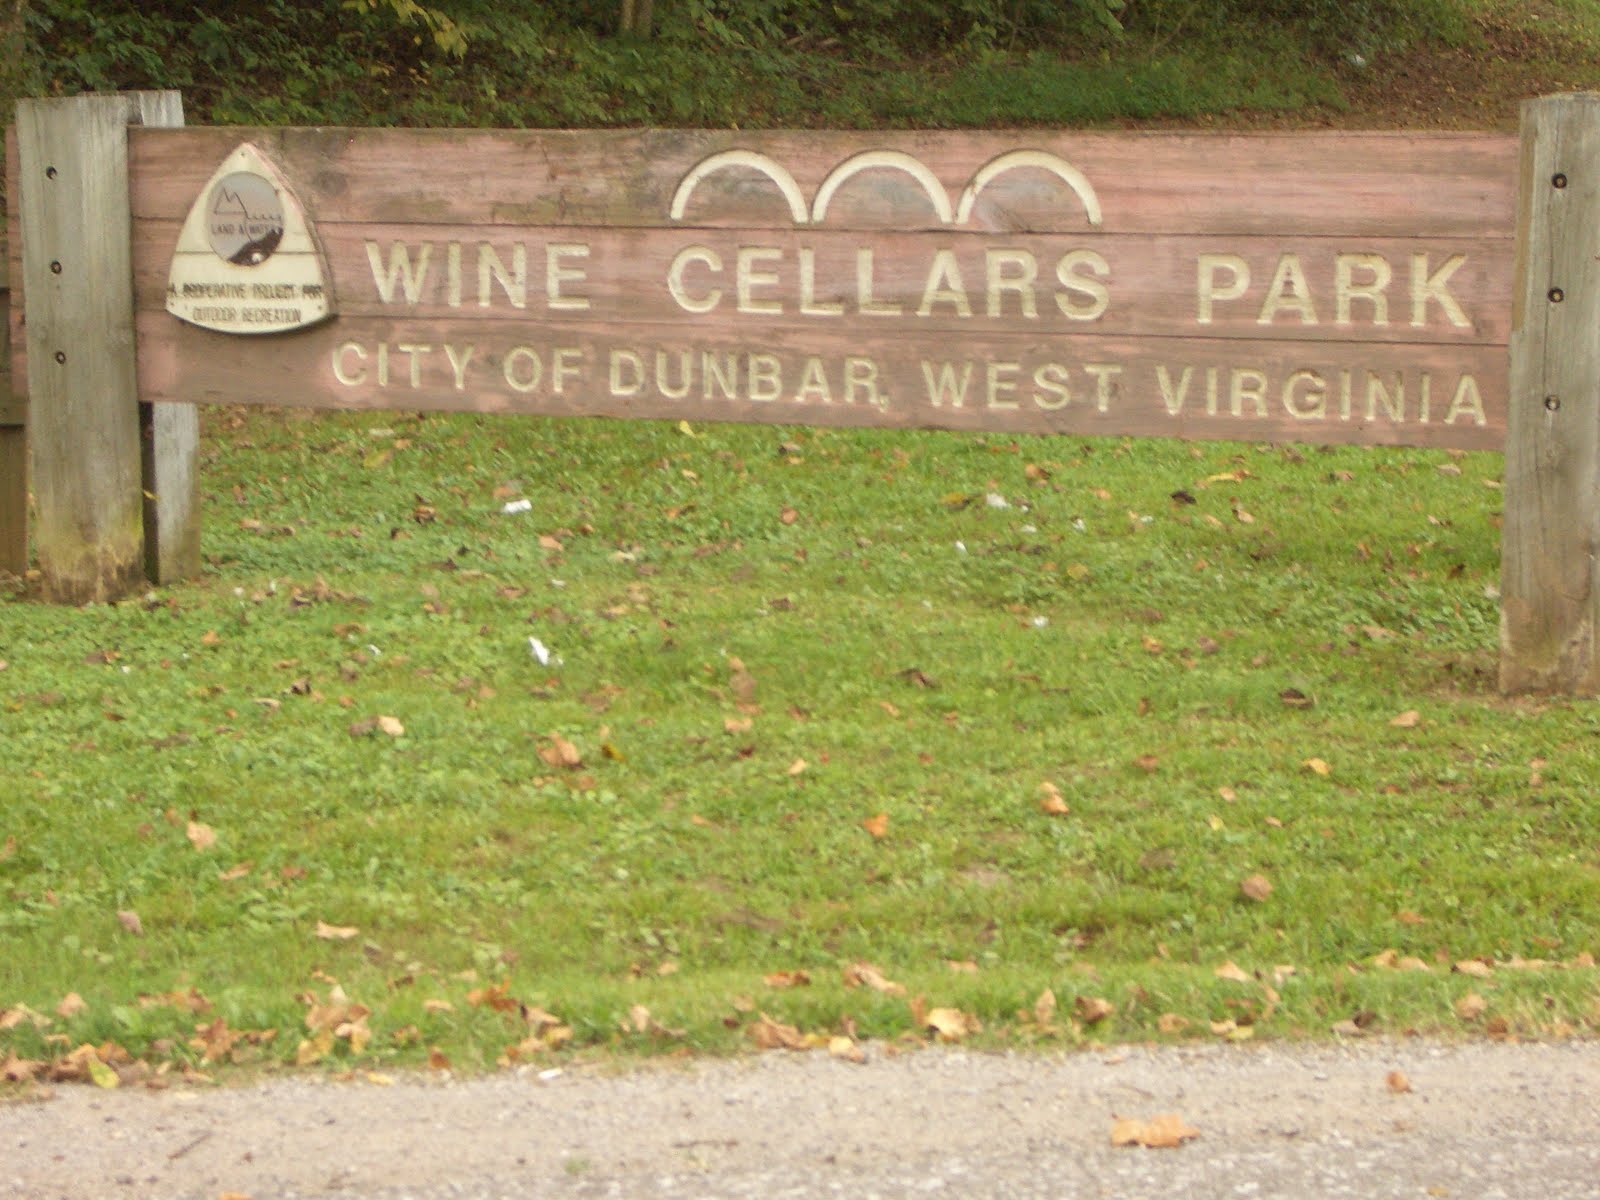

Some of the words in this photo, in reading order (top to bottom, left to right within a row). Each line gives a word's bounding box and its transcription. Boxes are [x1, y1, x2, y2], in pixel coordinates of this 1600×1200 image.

[211, 224, 234, 235] LAND
[366, 240, 591, 310] WINE
[668, 243, 1111, 321] CELLARS
[1196, 252, 1474, 329] PARK
[193, 307, 236, 321] OUTDOOR
[242, 307, 302, 322] RECREATION
[331, 342, 475, 390] CITY
[503, 346, 584, 393] OF
[609, 348, 890, 413] DUNBAR,
[920, 360, 1122, 414] WEST
[1155, 365, 1489, 427] VIRGINIA
